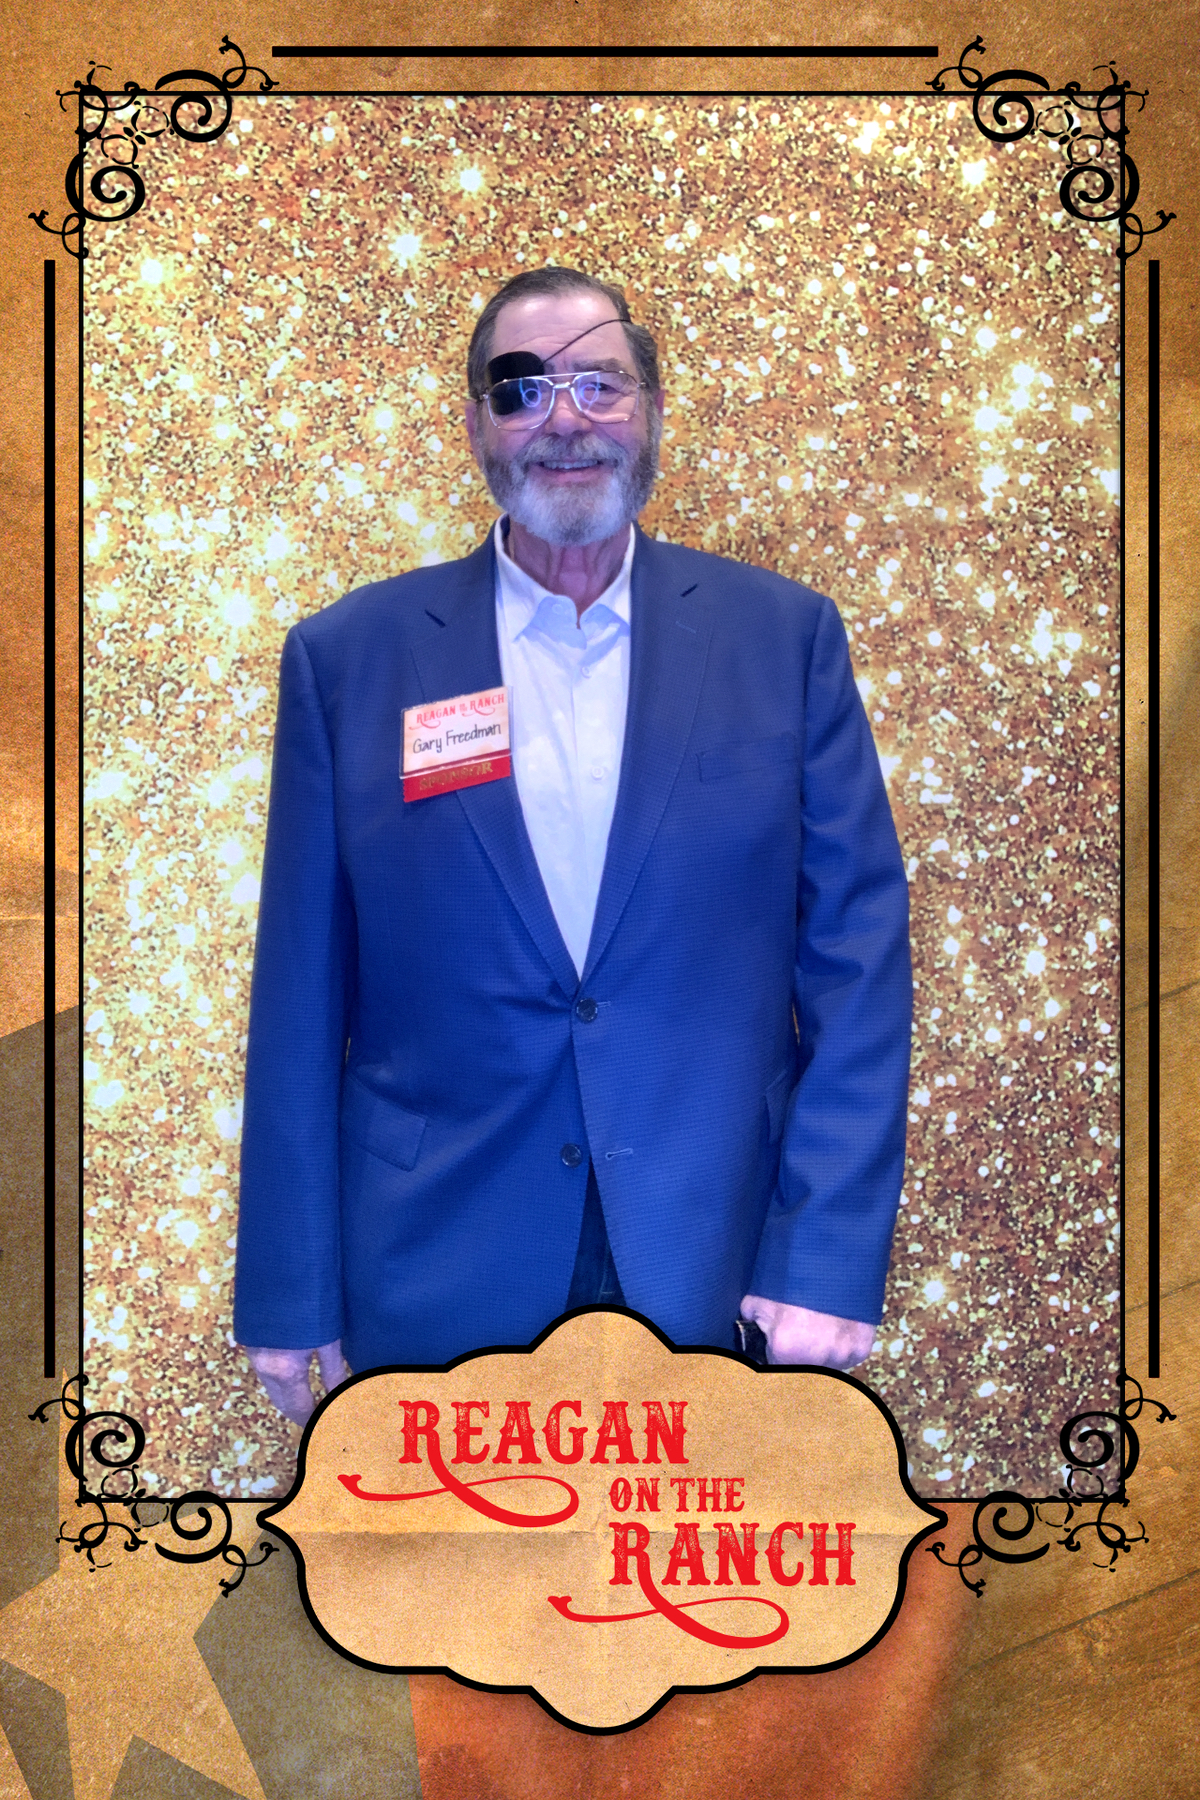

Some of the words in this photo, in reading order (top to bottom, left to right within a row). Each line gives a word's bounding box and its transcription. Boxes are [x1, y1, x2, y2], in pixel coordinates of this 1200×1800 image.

[416, 704, 456, 724] REAGAN
[470, 693, 505, 711] RANCH
[413, 737, 443, 754] Gary
[446, 723, 502, 746] Freedman
